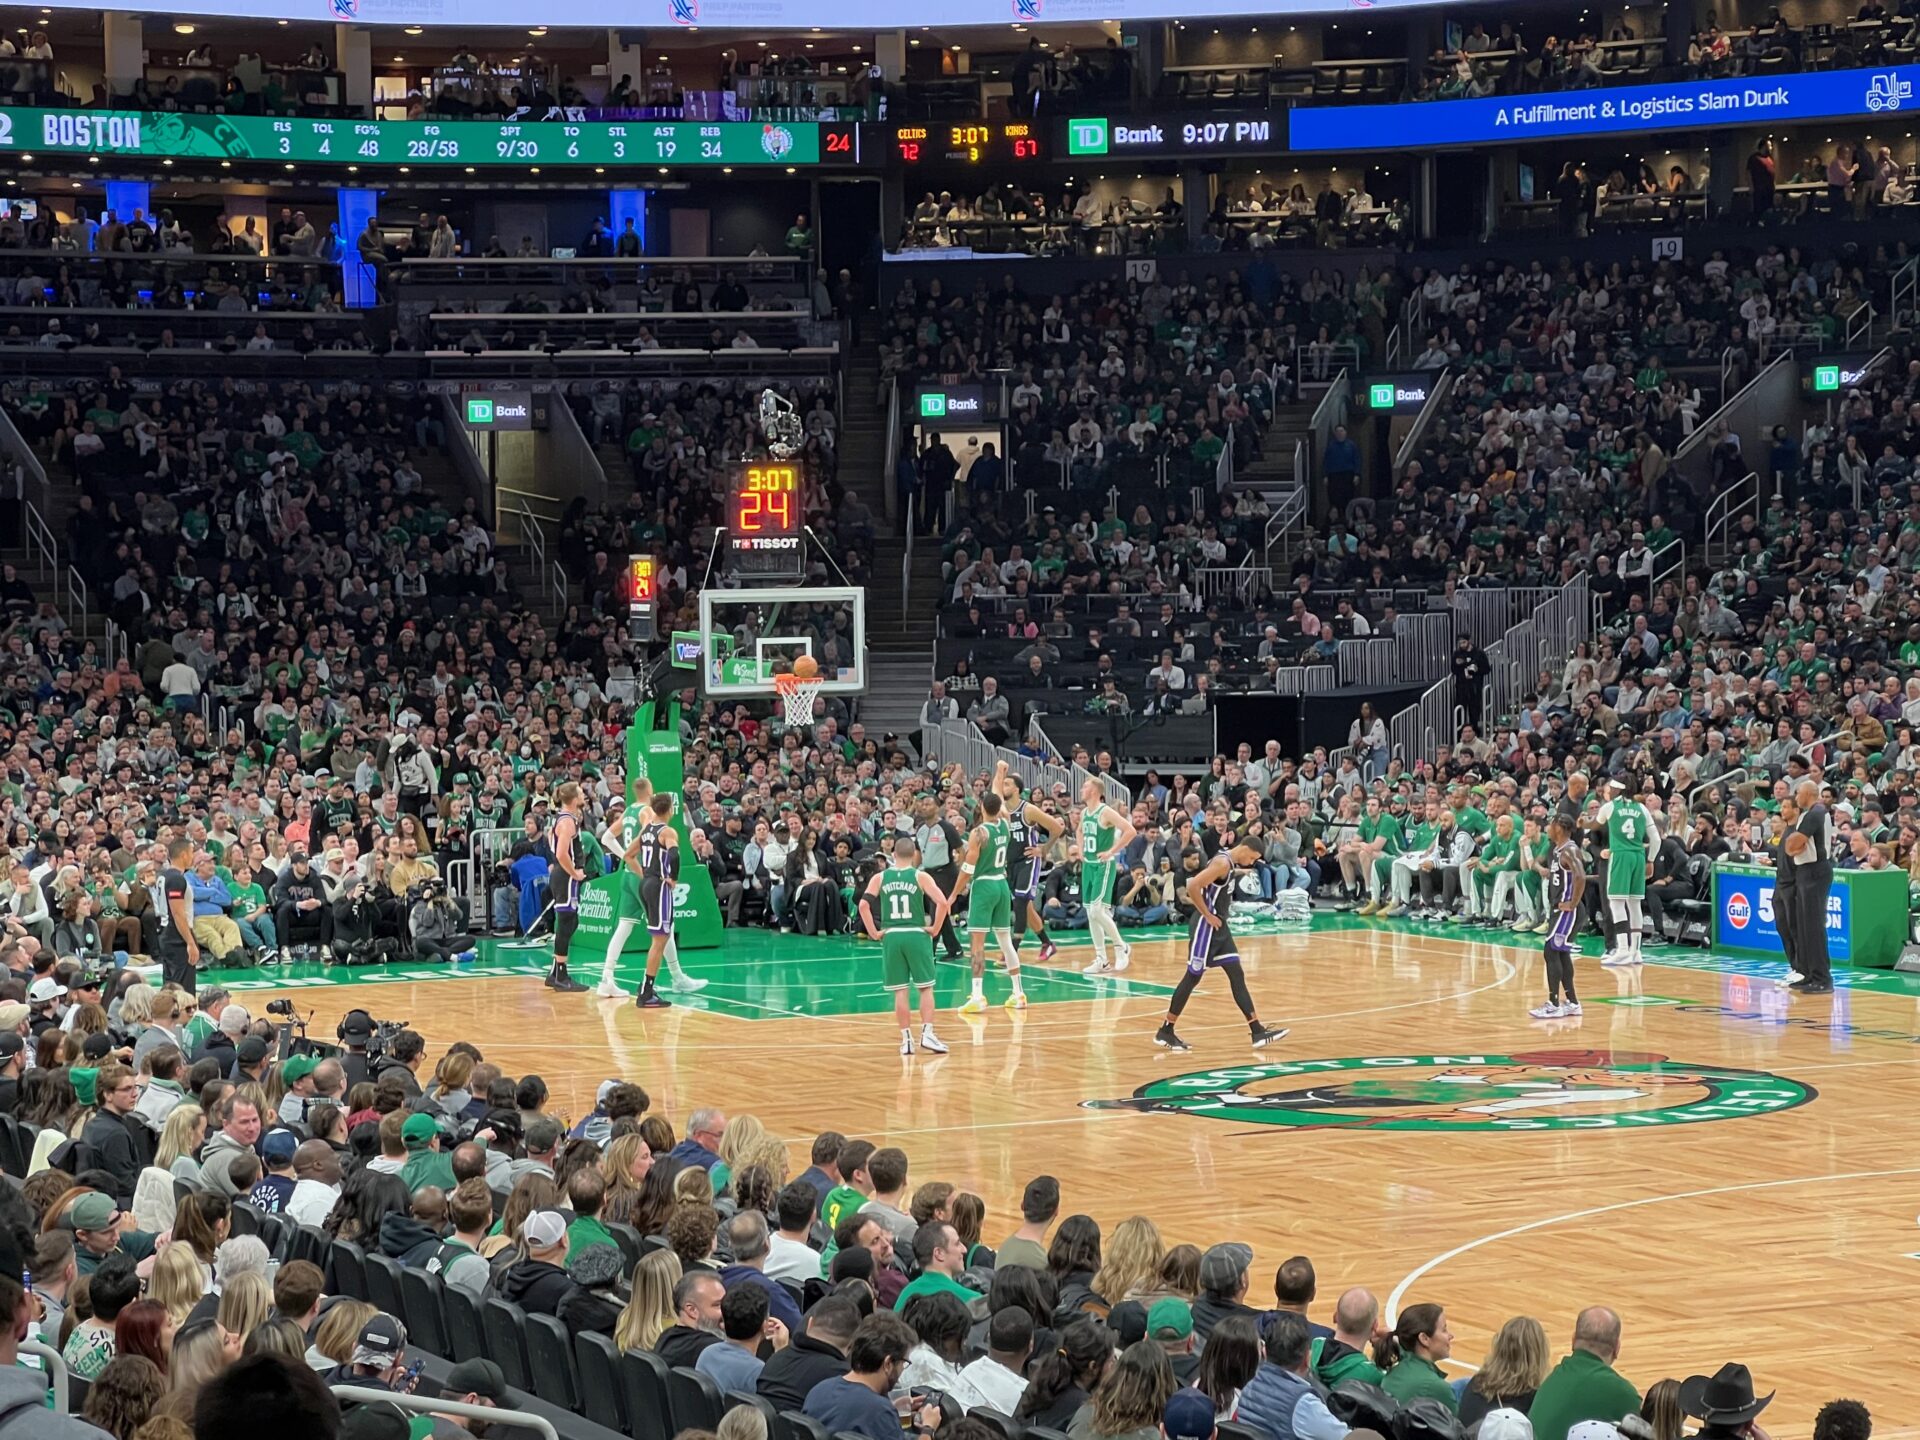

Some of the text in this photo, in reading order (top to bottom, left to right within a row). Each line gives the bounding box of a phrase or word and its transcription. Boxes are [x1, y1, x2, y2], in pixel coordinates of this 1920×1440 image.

[1495, 86, 1789, 126] A Fulfillment & Logistics Slam Dunk
[43, 113, 140, 148] BOSTON
[273, 122, 292, 132] FLS
[312, 123, 334, 134] TOL
[354, 124, 380, 136] FG%
[424, 126, 440, 136] FG
[500, 126, 521, 136] 3PT
[563, 126, 580, 137] TO
[608, 126, 627, 137] STL
[653, 127, 675, 137] AST
[700, 127, 721, 137] REB
[898, 128, 927, 140] CELTICS
[1005, 125, 1029, 137] KINGS
[1183, 121, 1270, 143] 9:07 PM
[826, 133, 850, 152] 24
[951, 127, 989, 145] 3:07
[1073, 125, 1164, 147] TD Bank
[279, 137, 290, 154] 3
[318, 138, 330, 155] 4
[357, 140, 379, 157] 48
[407, 140, 459, 158] 28/58
[496, 141, 538, 158] 9/30
[567, 142, 579, 158] 6
[613, 142, 625, 158] 3
[656, 142, 676, 158] 19
[701, 142, 722, 158] 34
[899, 144, 919, 160] 72
[1014, 140, 1037, 157] 67
[969, 147, 979, 162] 3
[1656, 241, 1677, 258] 19
[1131, 263, 1150, 280] 19
[1373, 388, 1426, 403] TD Bank
[471, 404, 490, 418] TD
[496, 404, 527, 417] Bank
[924, 398, 942, 412] TD
[948, 398, 978, 410] Bank
[747, 469, 793, 491] 3:07
[739, 492, 788, 530] 24
[751, 537, 799, 550] TISSOT
[1013, 831, 1024, 842] 41
[1621, 818, 1636, 839] 4
[624, 827, 633, 849] 8
[994, 846, 1006, 869] 0
[882, 880, 918, 895] PRITCHARD
[889, 894, 913, 919] 11
[1728, 904, 1749, 917] Gulf
[1826, 895, 1842, 912] ER
[1169, 1056, 1486, 1088] BOSTON
[1491, 1089, 1799, 1130] CELTICS
